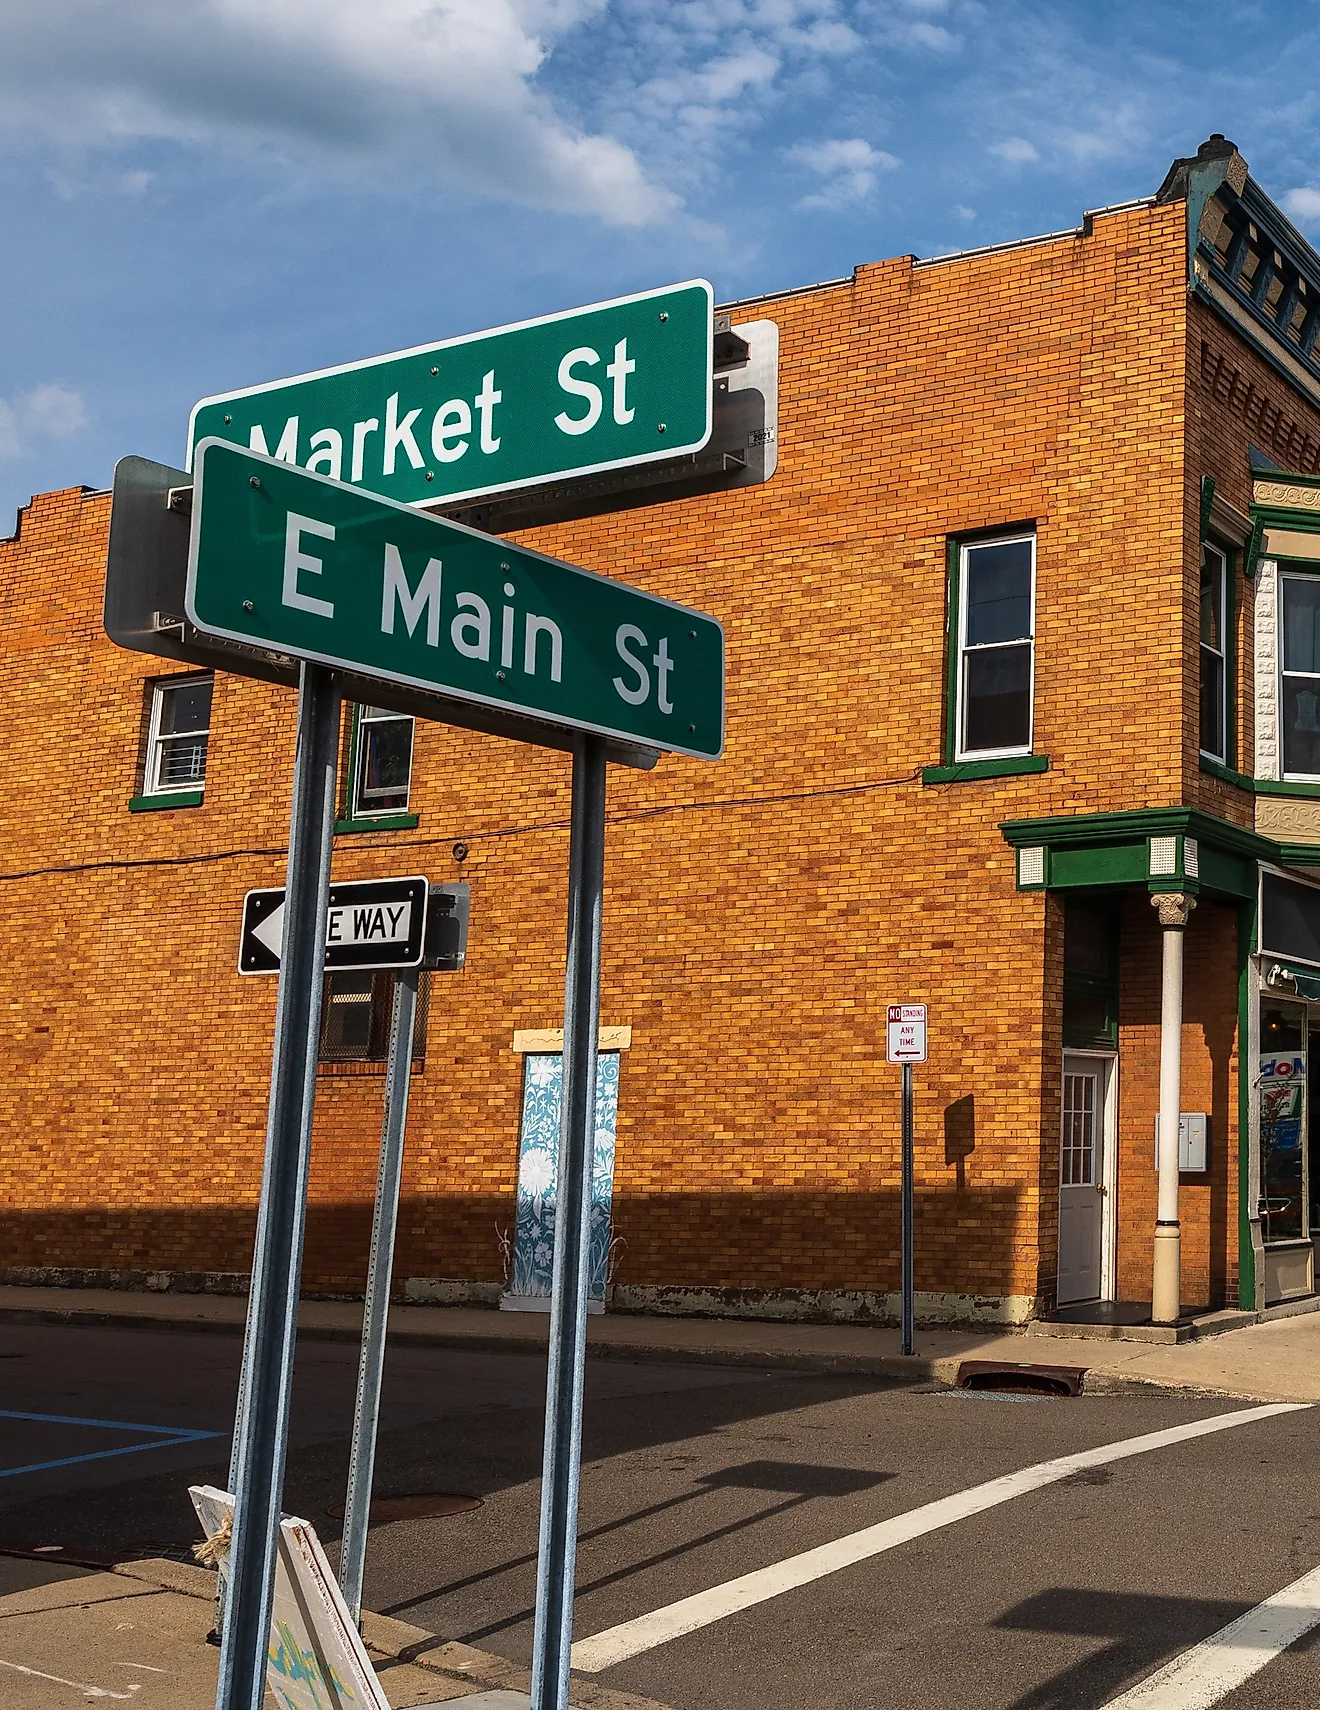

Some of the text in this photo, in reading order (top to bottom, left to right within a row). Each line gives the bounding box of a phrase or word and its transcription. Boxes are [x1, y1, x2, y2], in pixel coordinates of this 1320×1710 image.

[554, 337, 636, 437] St
[753, 431, 771, 442] 2021
[281, 510, 675, 716] E Main St
[353, 905, 405, 940] WAY
[889, 1008, 923, 1020] NO STANDING
[900, 1026, 915, 1034] ANY
[899, 1038, 916, 1046] TIME
